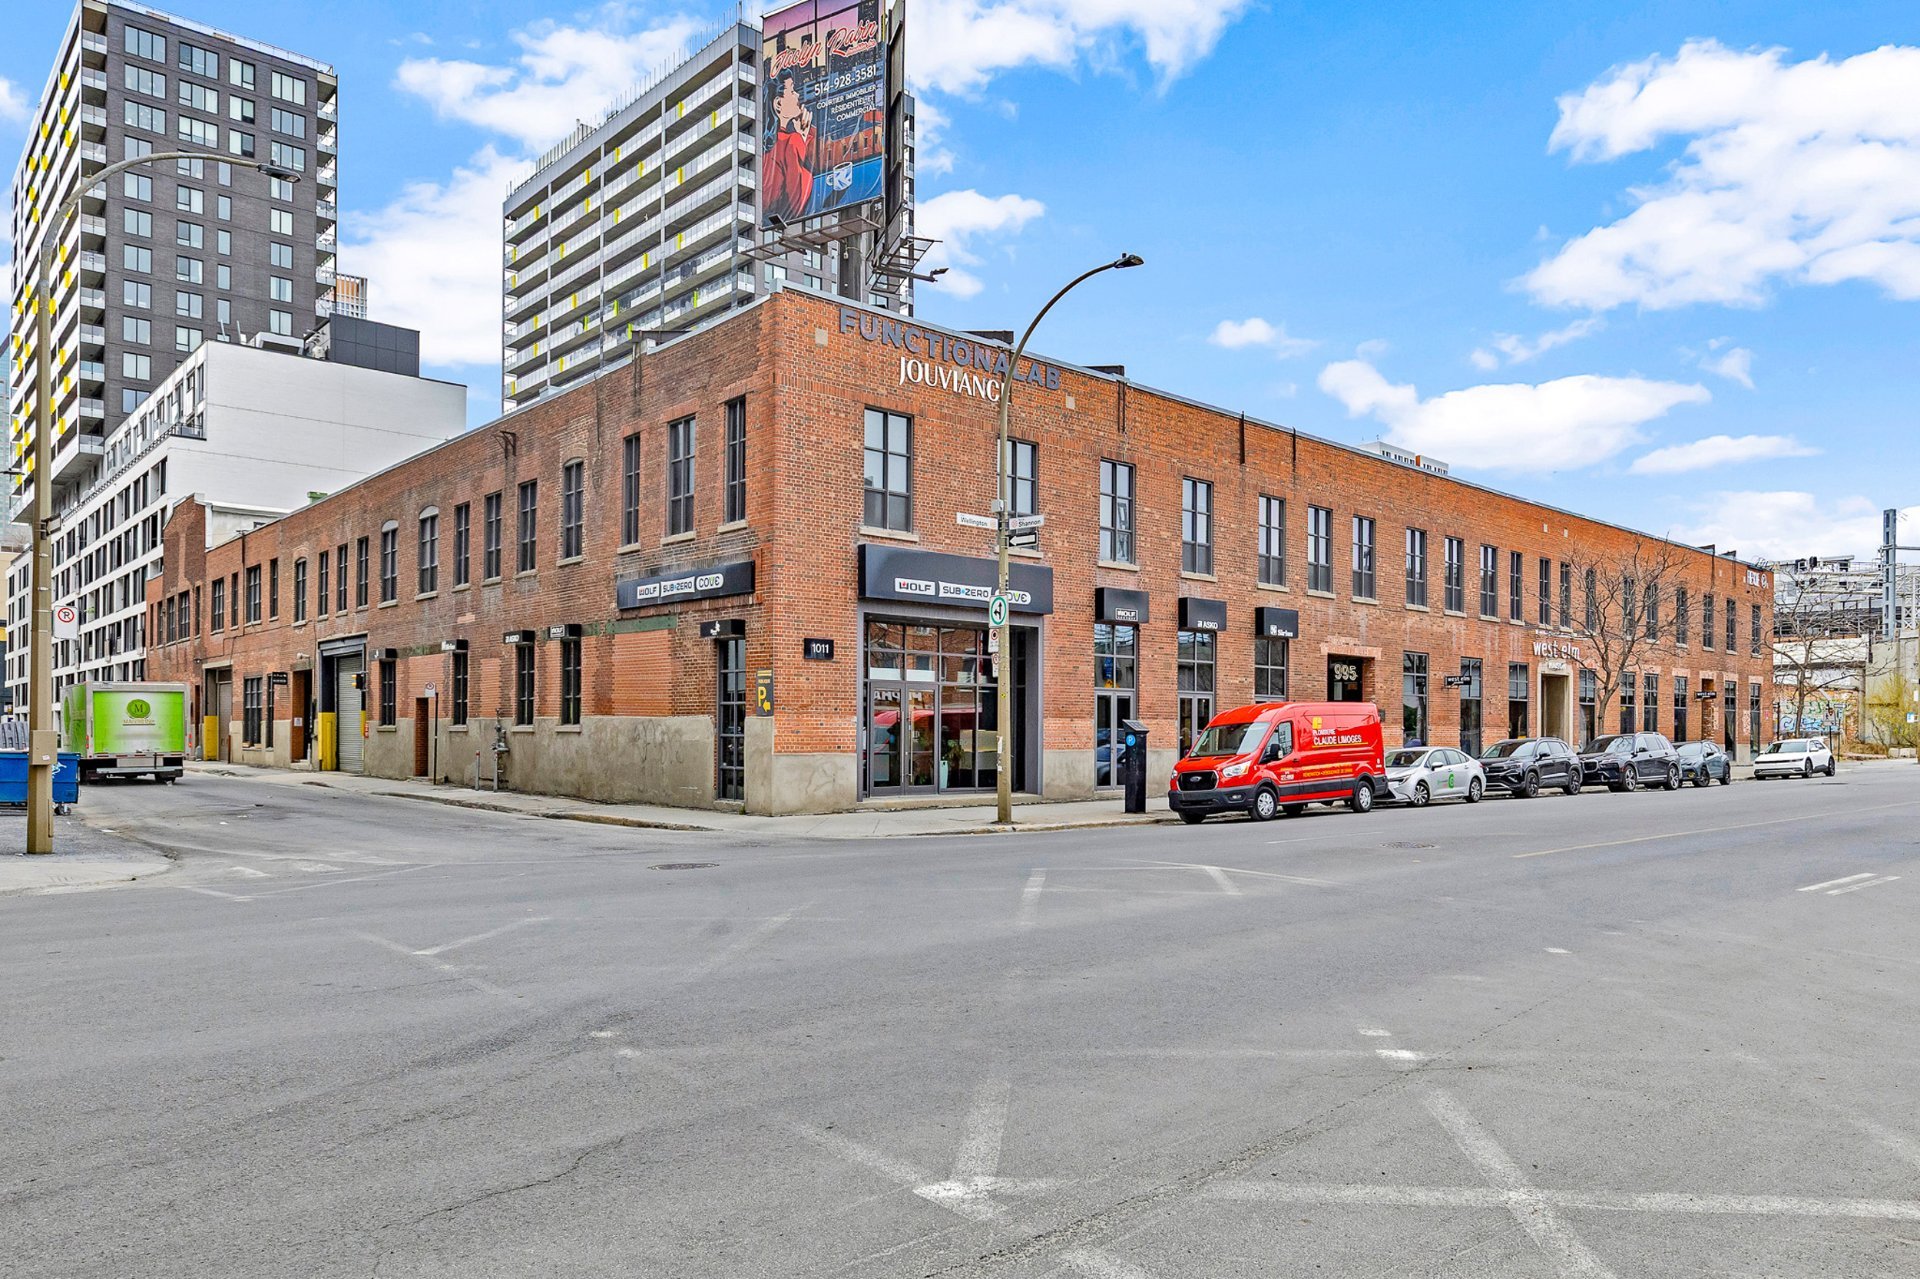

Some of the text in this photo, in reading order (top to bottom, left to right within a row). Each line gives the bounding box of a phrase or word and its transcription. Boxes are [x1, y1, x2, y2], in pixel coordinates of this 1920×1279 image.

[814, 64, 877, 96] 514-928-3581
[961, 516, 988, 527] Wellington
[1019, 519, 1041, 528] Shannon
[639, 586, 657, 596] WOLF
[699, 576, 720, 588] COVE
[899, 581, 931, 592] WOLF
[1203, 620, 1218, 629] ASKO
[811, 643, 829, 654] 1011
[1533, 640, 1580, 660] west elm
[1334, 663, 1358, 681] 995
[758, 687, 767, 707] P
[134, 703, 143, 713] M
[1313, 734, 1363, 746] CLAUDE LIMOGES
